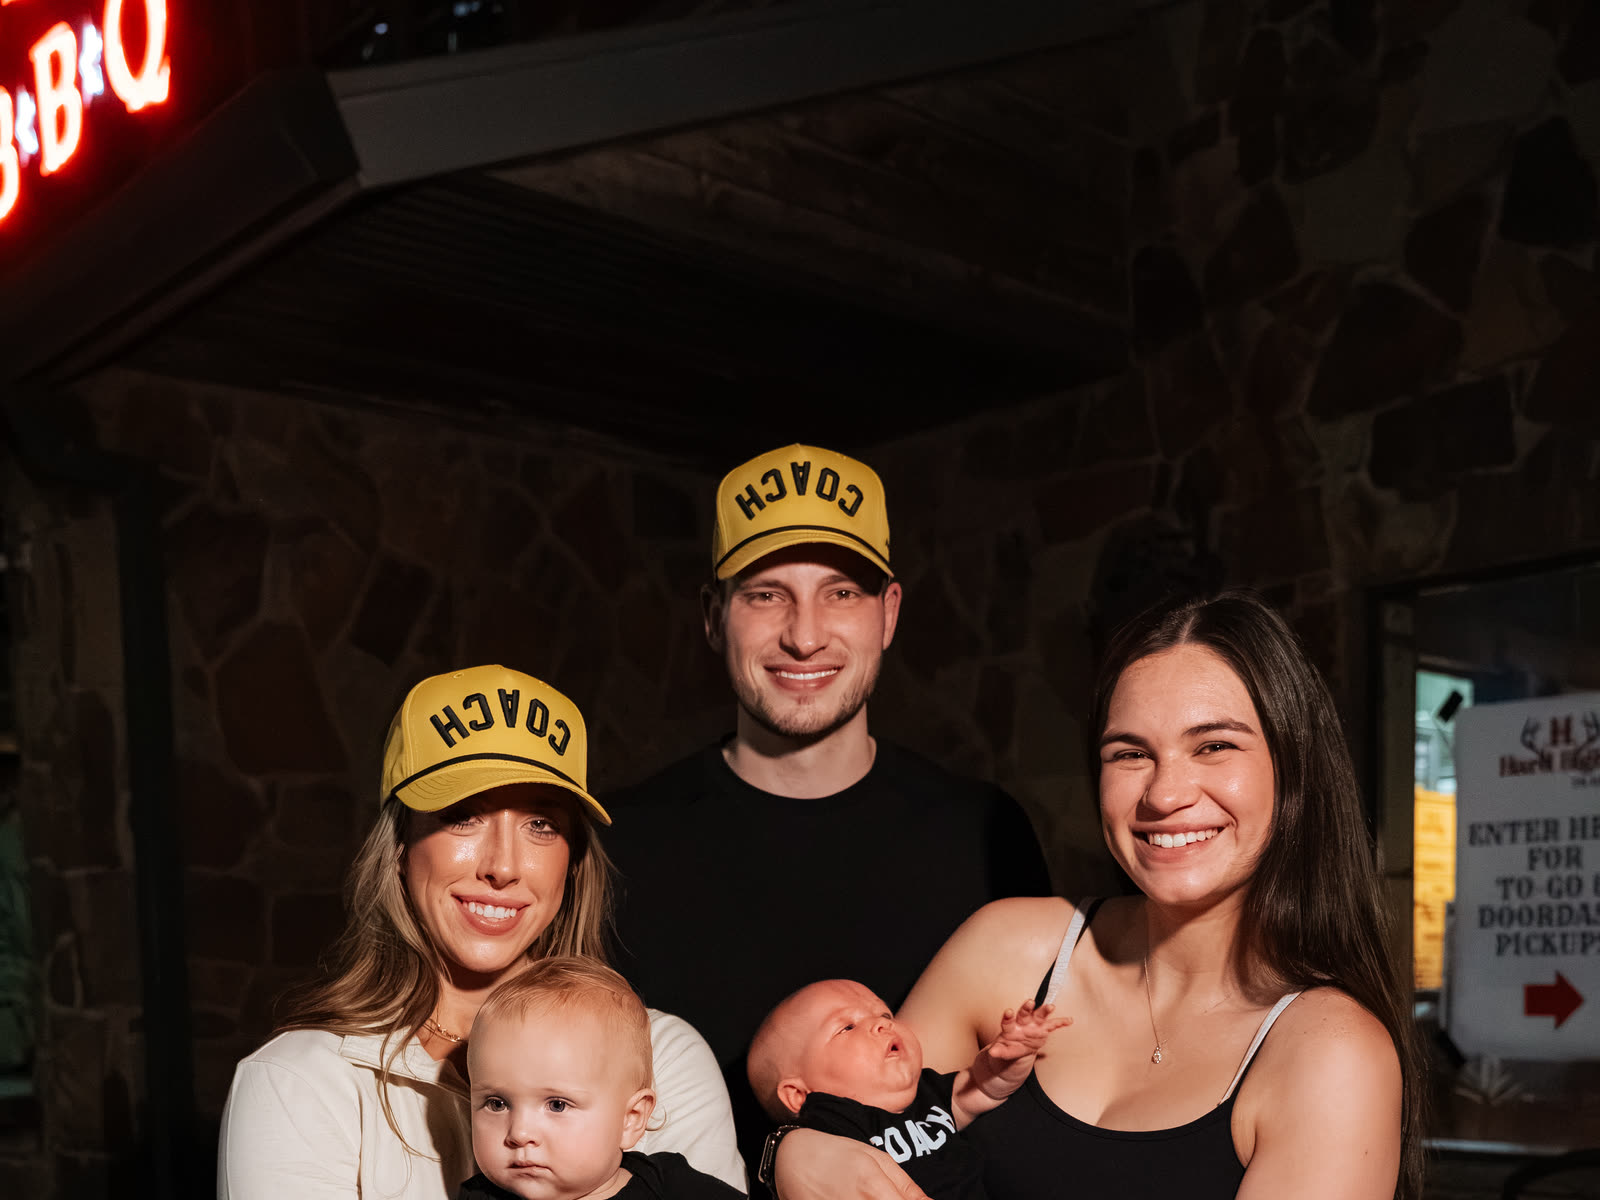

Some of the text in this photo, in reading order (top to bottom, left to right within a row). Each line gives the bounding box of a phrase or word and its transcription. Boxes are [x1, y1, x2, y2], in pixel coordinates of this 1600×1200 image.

[735, 461, 864, 521] COACH
[430, 688, 571, 756] COACH
[1469, 819, 1560, 846] ENTER
[1527, 846, 1583, 872] FOR
[1496, 877, 1534, 901] TO
[1547, 874, 1583, 900] GO
